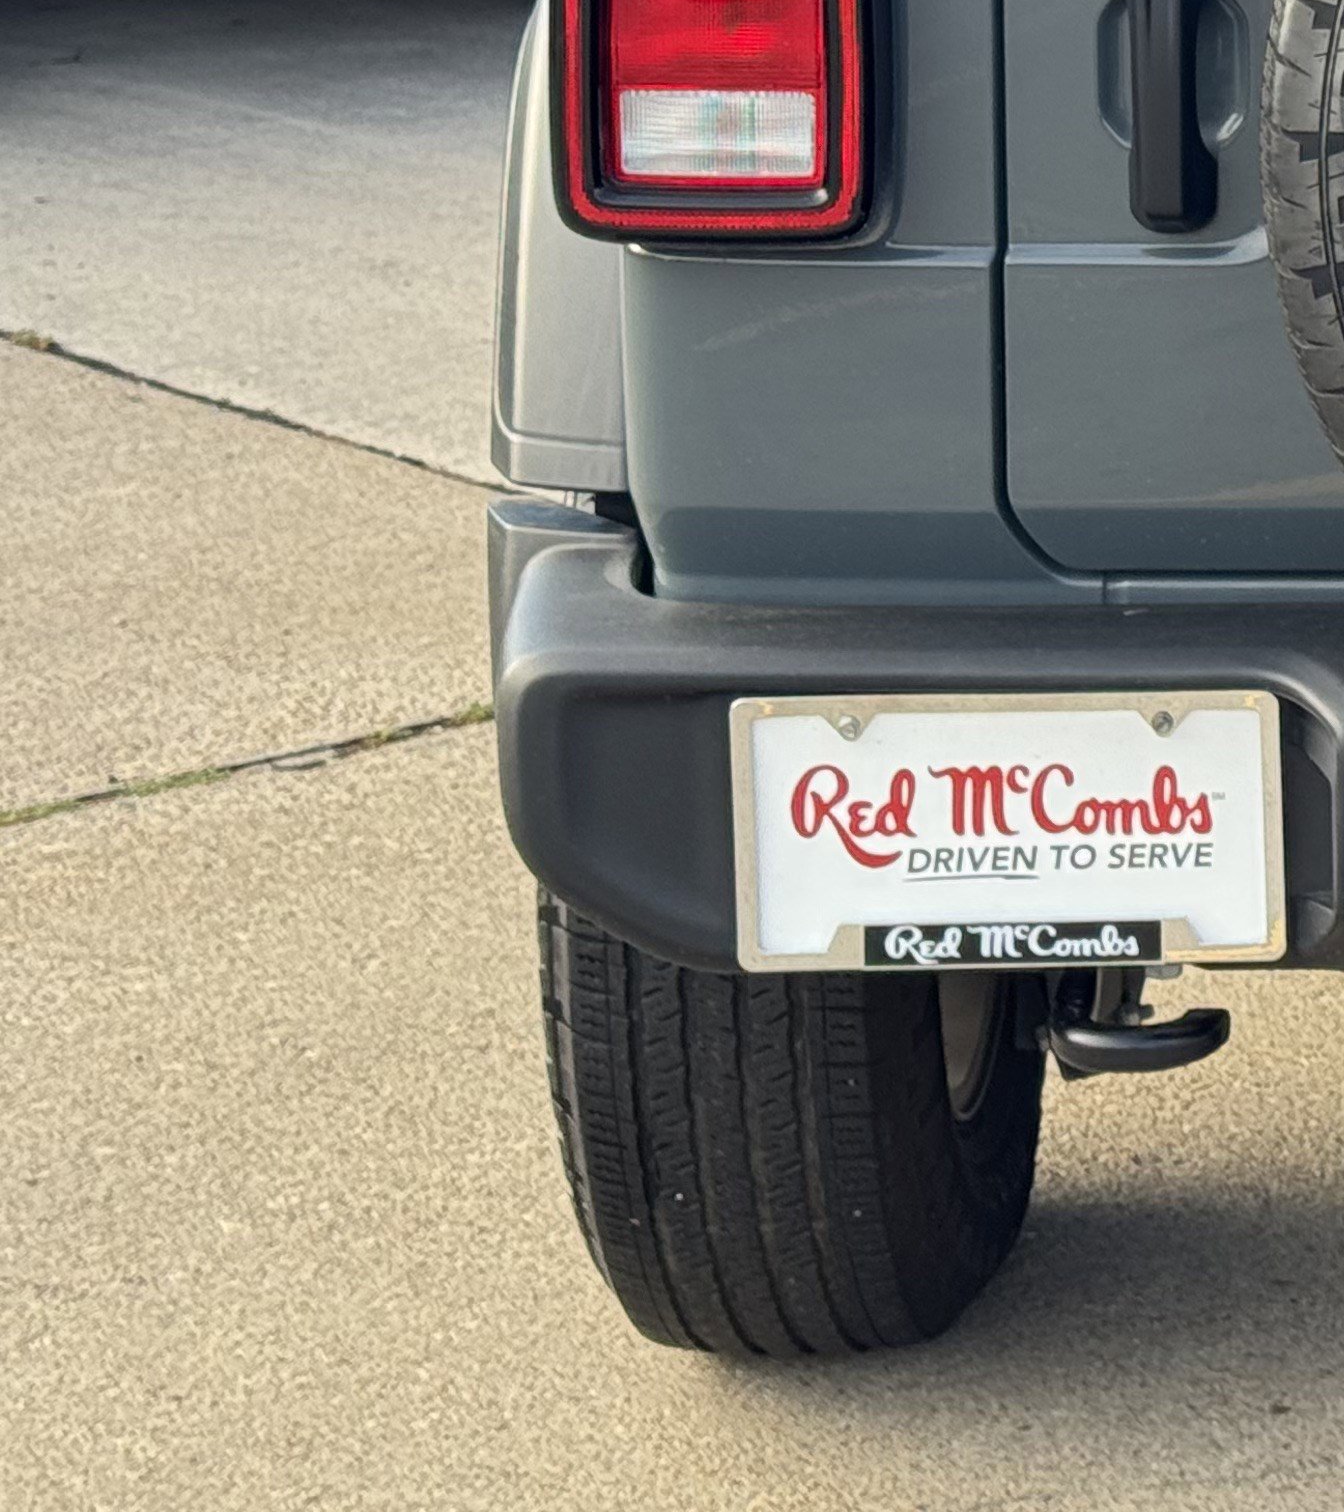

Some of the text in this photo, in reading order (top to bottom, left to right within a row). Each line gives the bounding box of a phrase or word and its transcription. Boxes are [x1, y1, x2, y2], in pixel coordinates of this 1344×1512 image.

[790, 764, 1213, 868] Red McCombs
[907, 841, 1213, 873] DRIVEN TO SERVE
[884, 924, 1140, 965] Red McCombs
